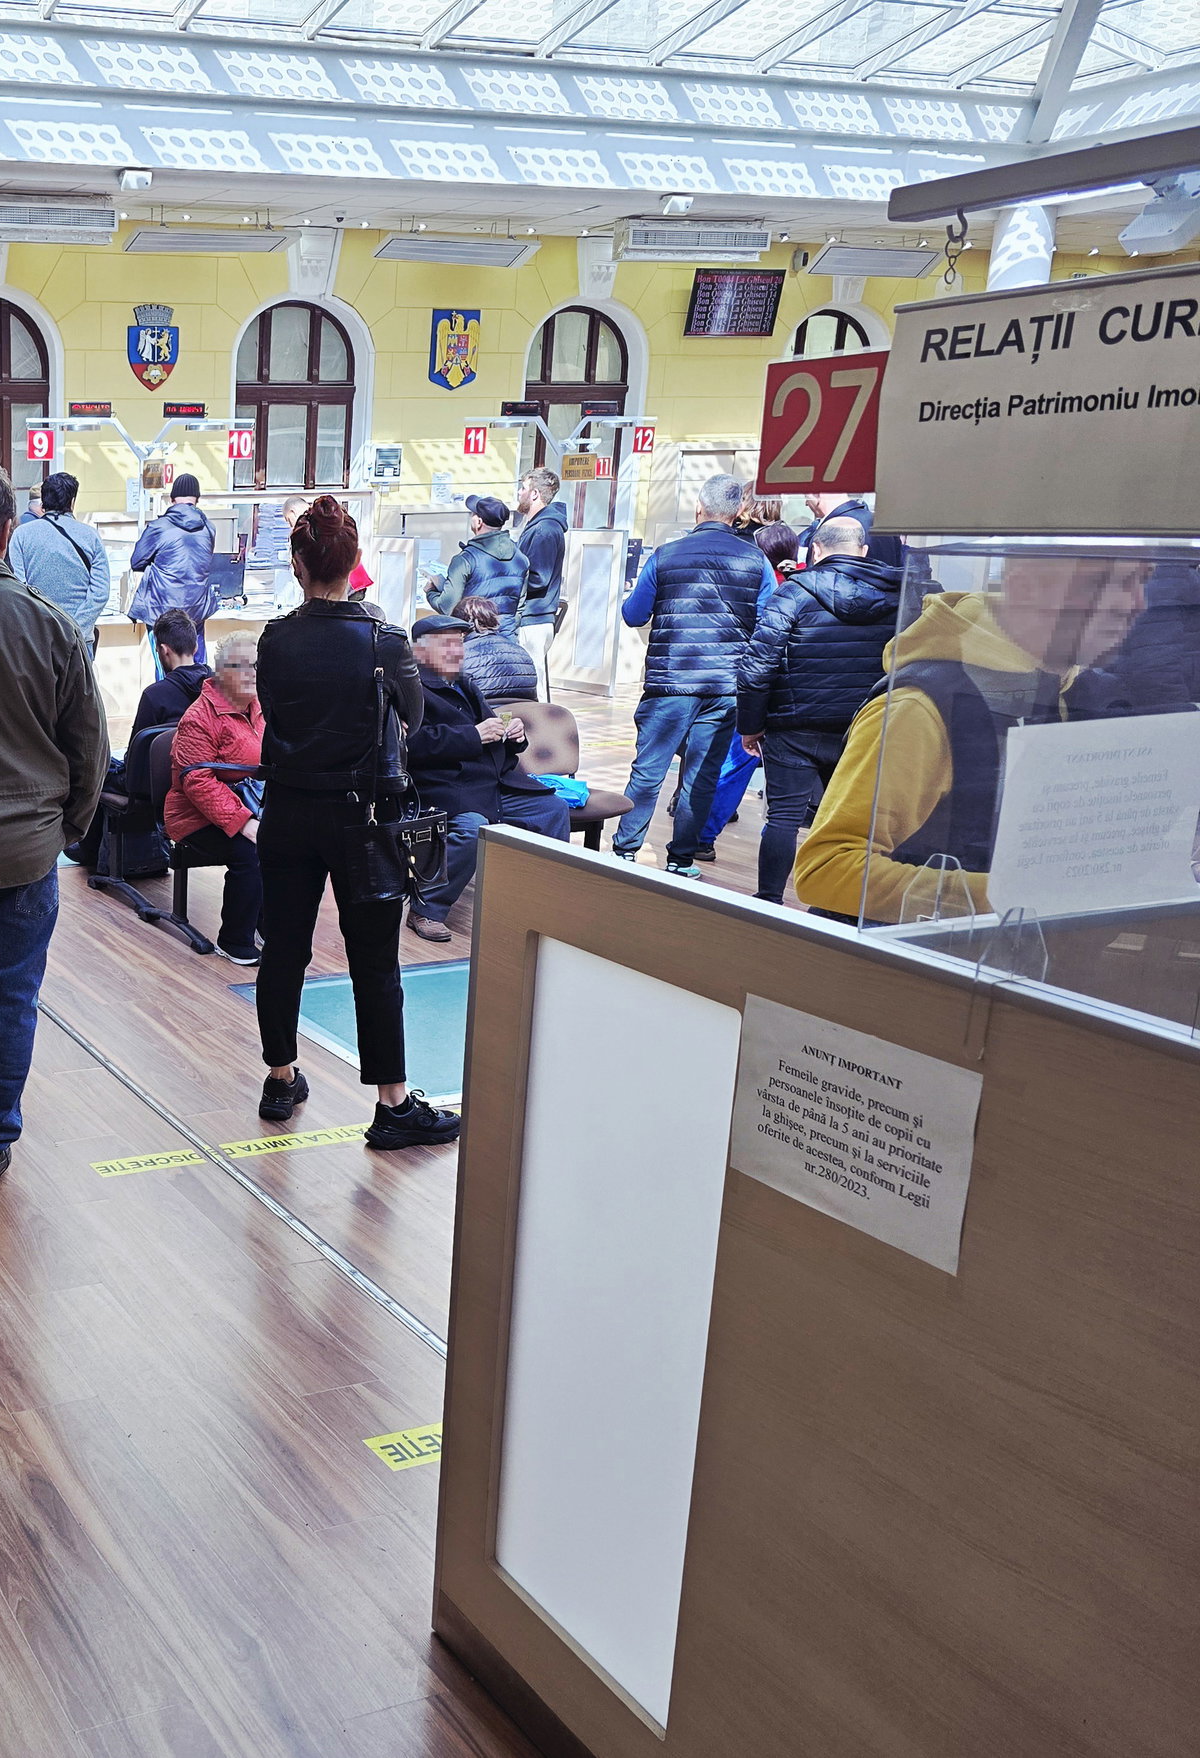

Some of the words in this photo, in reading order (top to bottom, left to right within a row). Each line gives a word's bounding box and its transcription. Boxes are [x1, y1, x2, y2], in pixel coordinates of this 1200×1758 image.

[920, 312, 1076, 364] RELAȚII
[1099, 299, 1200, 345] CUR
[919, 397, 1001, 426] Direcția
[1007, 387, 1140, 417] Patrimoniu
[1147, 385, 1200, 409] Imo
[467, 429, 484, 452] 11
[635, 429, 653, 451] 12
[765, 367, 879, 483] 27
[33, 432, 49, 458] 9
[229, 432, 252, 457] 10
[166, 465, 173, 482] 9
[599, 459, 609, 475] 11
[837, 1057, 903, 1090] IMPORTANT
[778, 1058, 819, 1086] Femeile
[820, 1079, 865, 1106] gravide,
[866, 1097, 910, 1123] precum
[768, 1076, 824, 1105] persoanele
[867, 1114, 882, 1130] de
[884, 1123, 914, 1143] copii
[916, 1136, 931, 1150] cu
[237, 1137, 303, 1152] LIMITA
[305, 1133, 333, 1145] LA
[756, 1088, 786, 1108] vârsta
[787, 1099, 801, 1114] de
[801, 1107, 827, 1126] până
[828, 1115, 839, 1131] la
[841, 1121, 849, 1134] 5
[851, 1128, 870, 1144] ani
[871, 1137, 886, 1151] au
[887, 1143, 943, 1174] prioritate
[761, 1104, 772, 1119] la
[809, 1128, 850, 1154] precum
[863, 1149, 875, 1165] la
[876, 1158, 931, 1189] serviciile
[757, 1123, 791, 1144] oferite
[792, 1136, 805, 1151] de
[805, 1145, 847, 1172] acestea,
[849, 1164, 896, 1194] conform
[897, 1183, 931, 1209] Legii
[804, 1161, 871, 1201] nr.280/2023.
[380, 1434, 441, 1463] EȚIE
